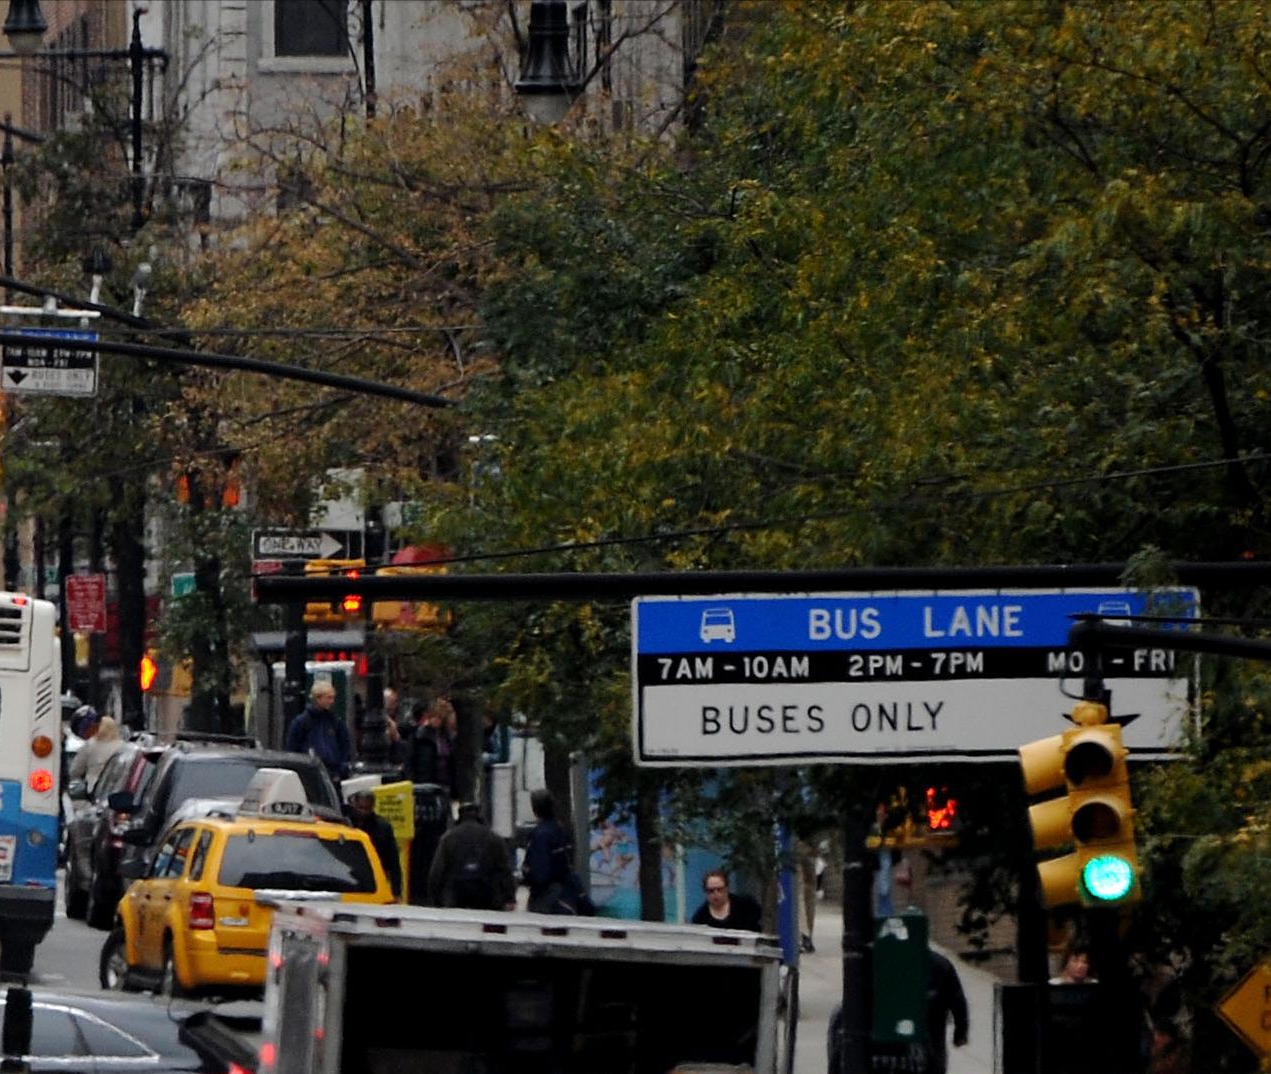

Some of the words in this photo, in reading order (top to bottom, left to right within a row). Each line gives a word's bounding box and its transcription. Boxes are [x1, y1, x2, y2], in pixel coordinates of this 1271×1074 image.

[807, 607, 883, 642] BUS
[923, 605, 1024, 639] LANE
[701, 705, 825, 736] BUSES
[851, 700, 945, 733] ONLY
